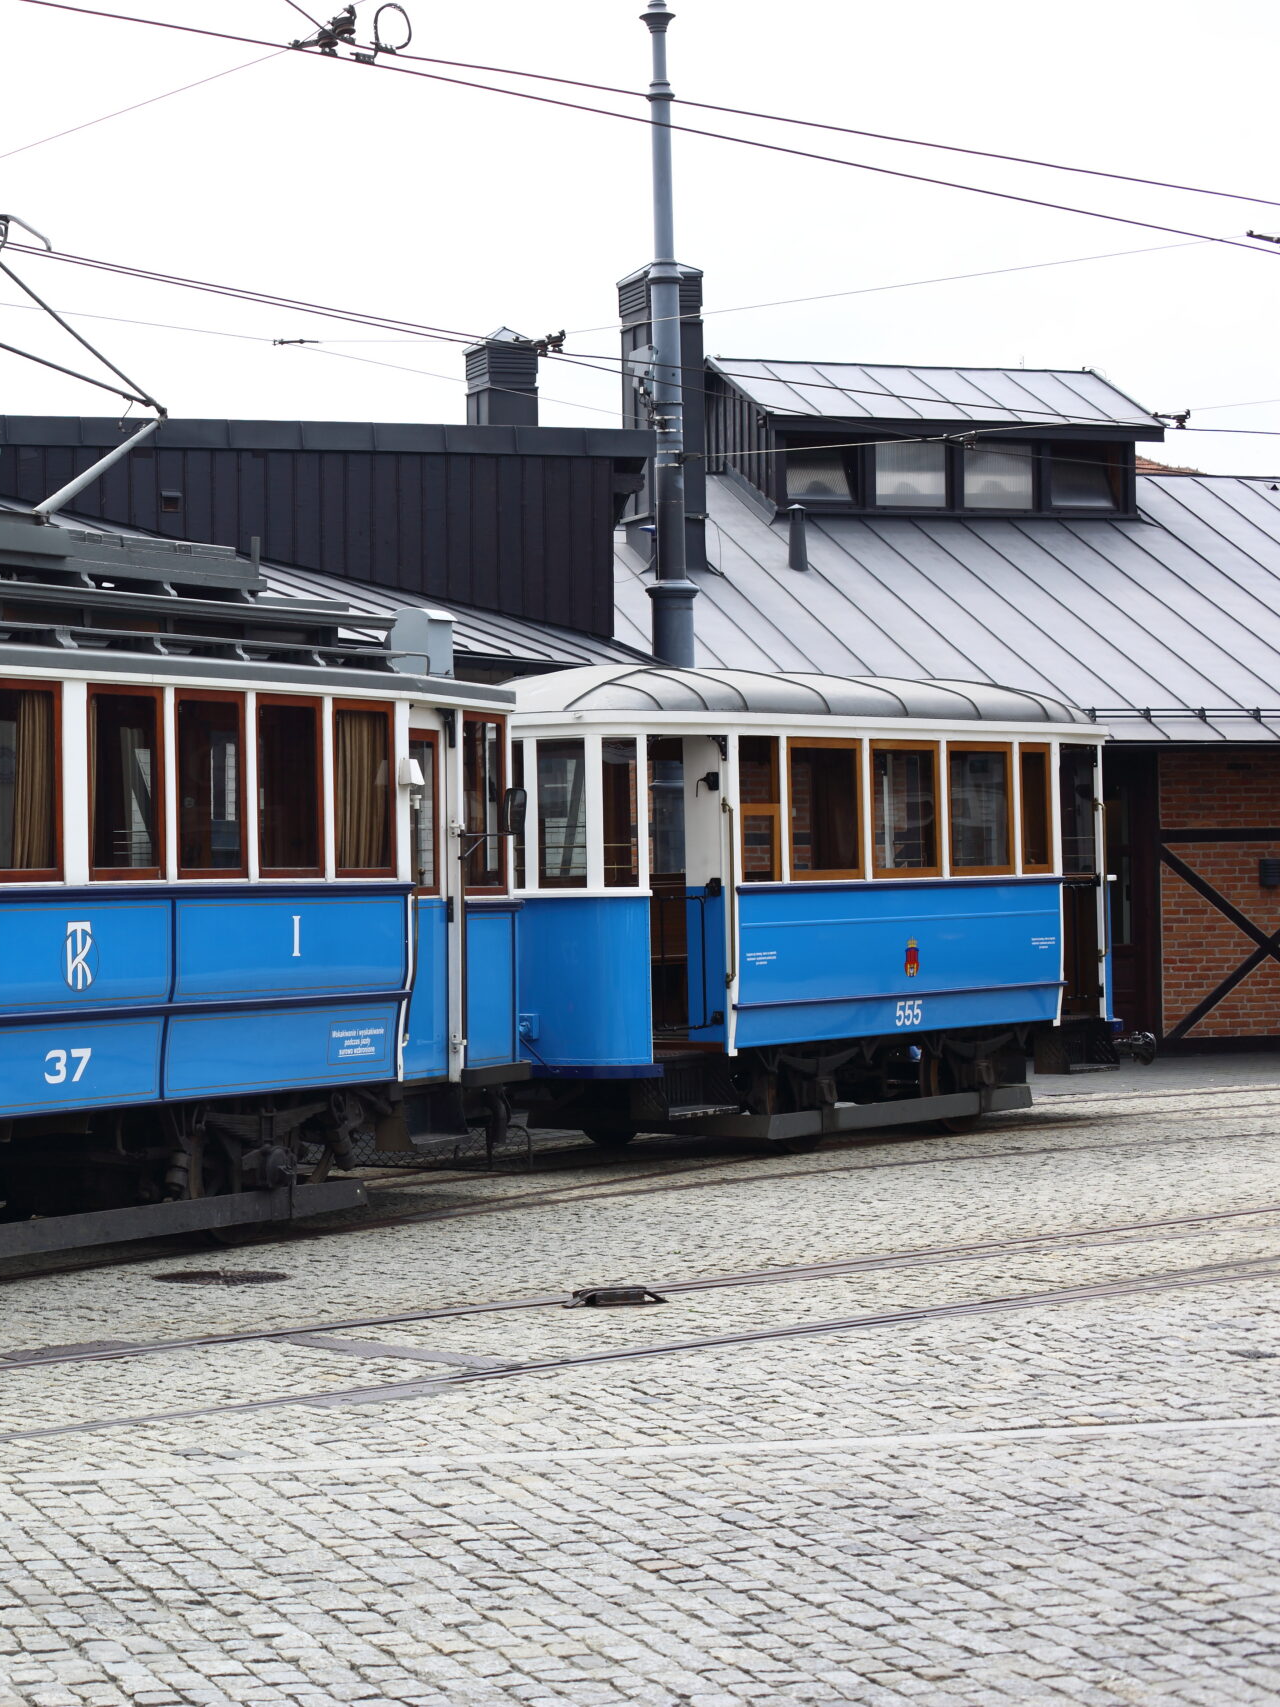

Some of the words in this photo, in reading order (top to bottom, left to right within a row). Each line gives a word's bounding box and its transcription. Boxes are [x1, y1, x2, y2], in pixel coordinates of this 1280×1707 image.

[292, 915, 301, 957] I
[895, 1000, 923, 1027] 555
[44, 1047, 92, 1084] 37
